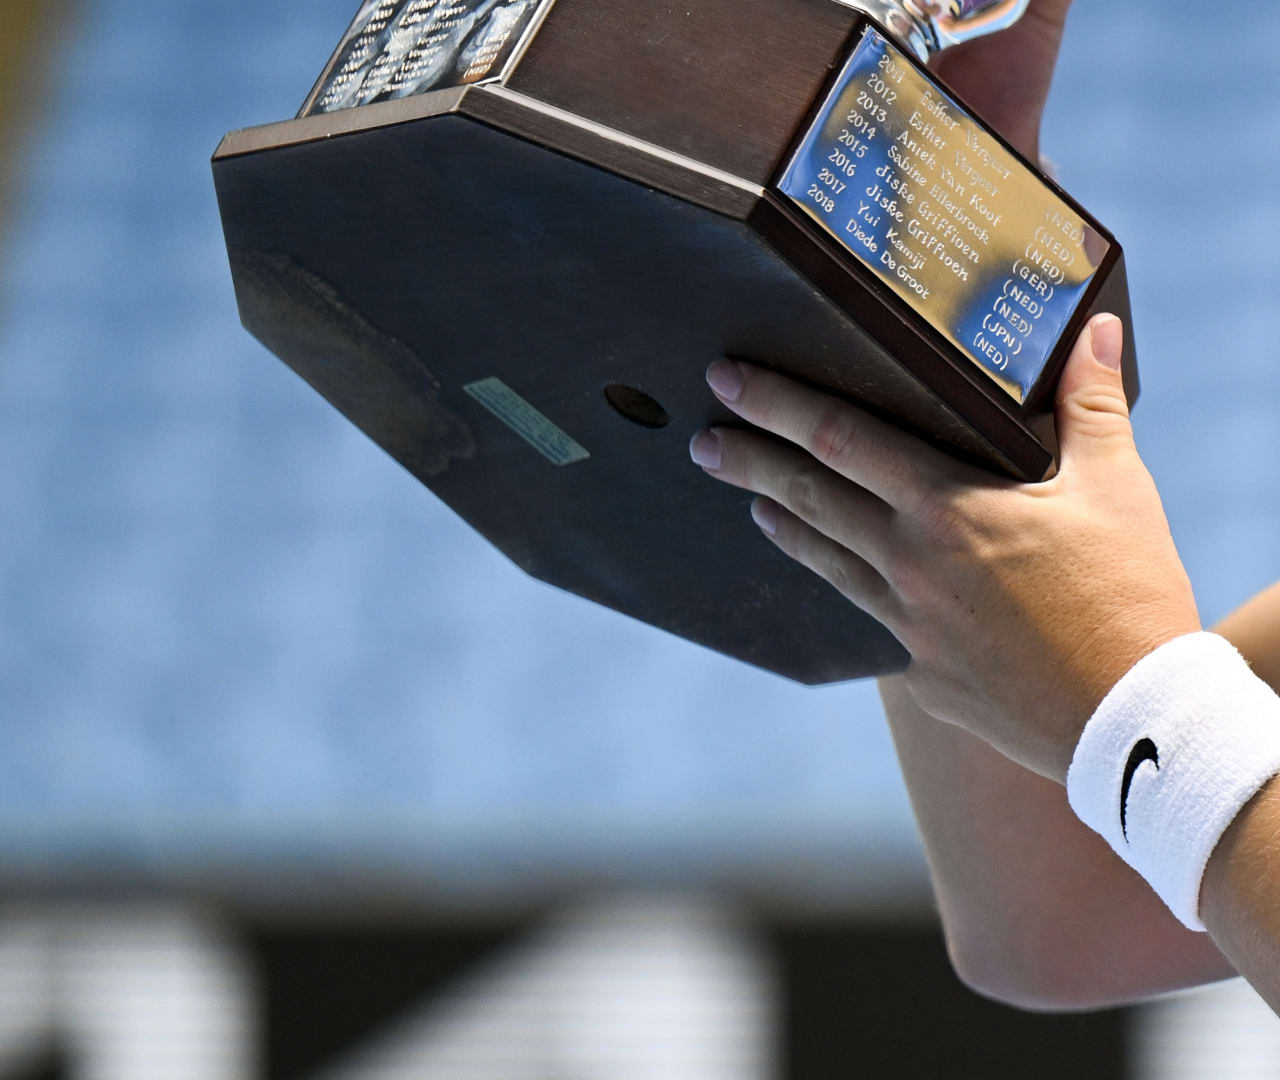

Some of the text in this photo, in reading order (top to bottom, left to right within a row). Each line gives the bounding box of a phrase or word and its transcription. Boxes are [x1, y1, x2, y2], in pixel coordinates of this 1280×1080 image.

[877, 52, 906, 84] 2011
[816, 164, 1023, 358] 2017 Yui Kamiji (JPN)
[827, 147, 1035, 340] 2016 Jiske Griffioen (NED)
[836, 126, 1045, 322] 2015 Jiske Griffioen (NED)
[845, 107, 1054, 303] 2014 Sabine Ellerbrock (GER)
[855, 89, 888, 125] 2013
[896, 126, 938, 171] Aniek
[1023, 241, 1066, 286] (NED)
[865, 71, 898, 107] 2012
[908, 108, 949, 153] Esther
[1033, 223, 1076, 269] (NED)
[806, 181, 1010, 372] 2018 Diede De Groot (NED)
